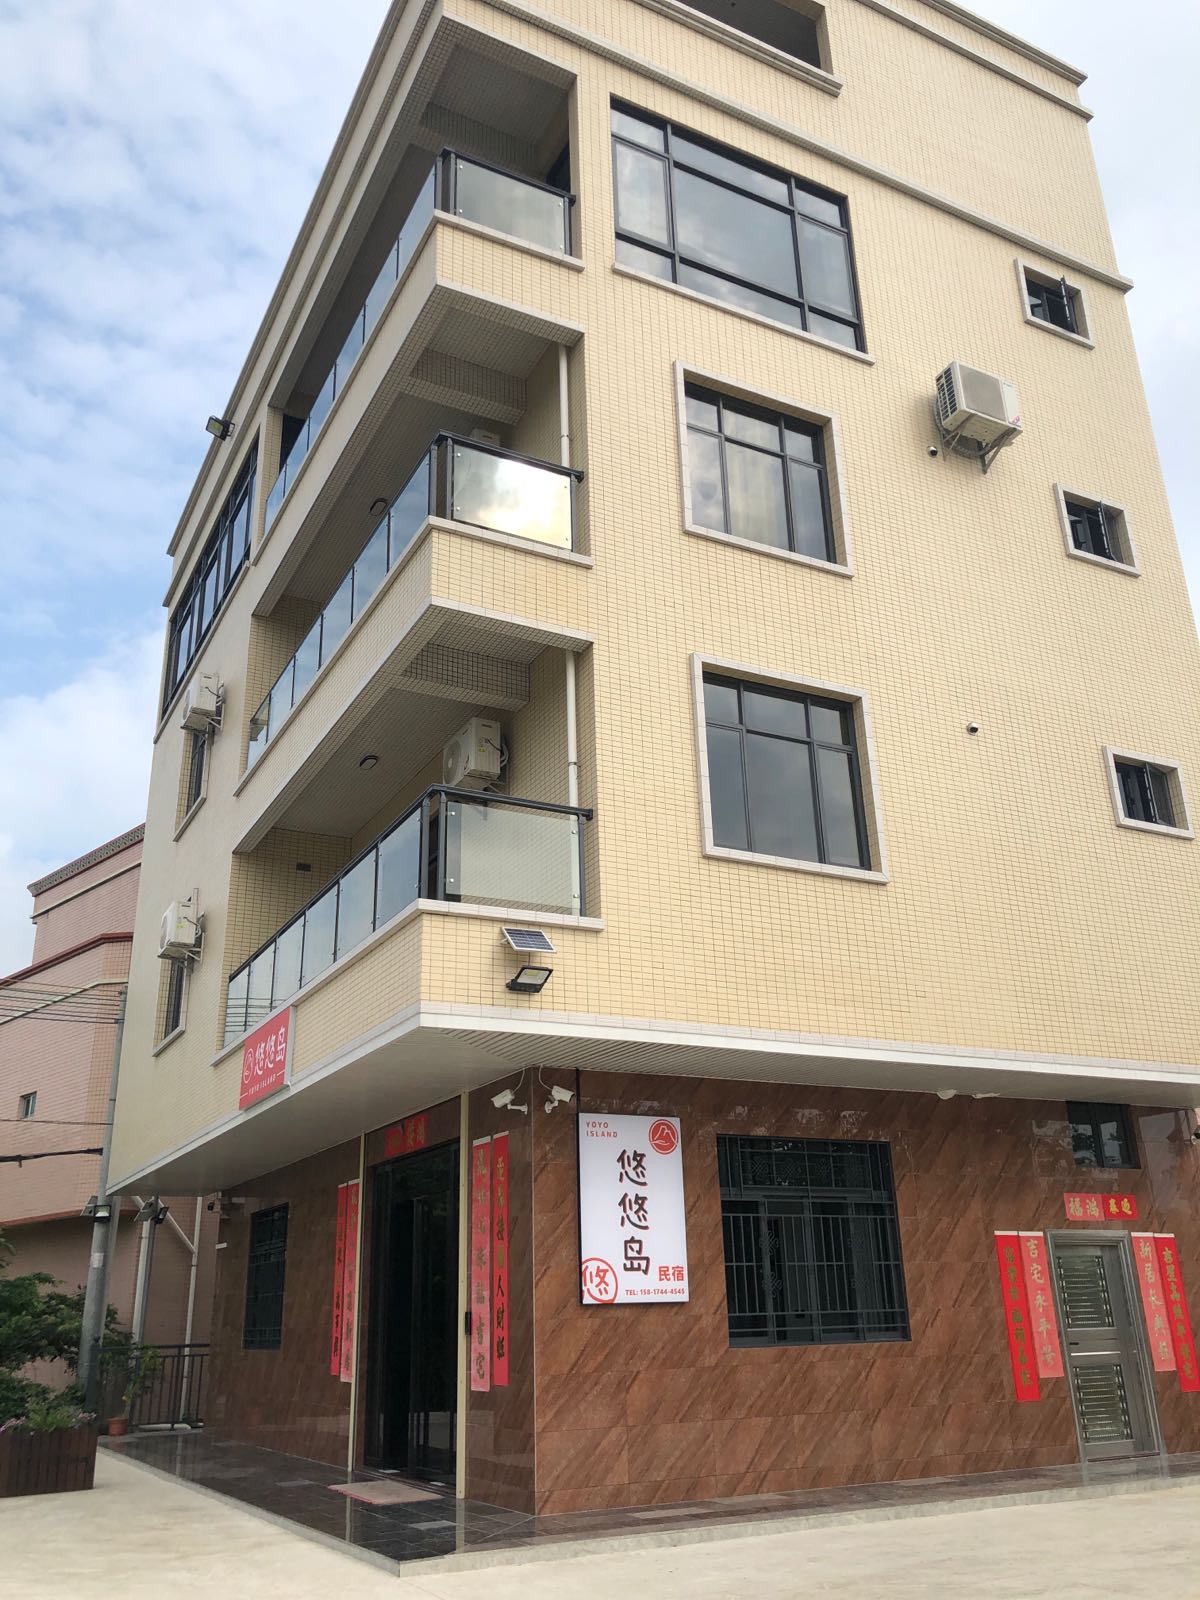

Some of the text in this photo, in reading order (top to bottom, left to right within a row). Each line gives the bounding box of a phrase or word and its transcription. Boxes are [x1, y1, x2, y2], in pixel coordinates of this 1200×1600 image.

[253, 1024, 286, 1076] 悠悠岛
[585, 1121, 609, 1129] YOYO
[586, 1130, 618, 1138] ISLAND
[616, 1149, 650, 1276] 悠悠岛
[658, 1265, 685, 1282] 民宿
